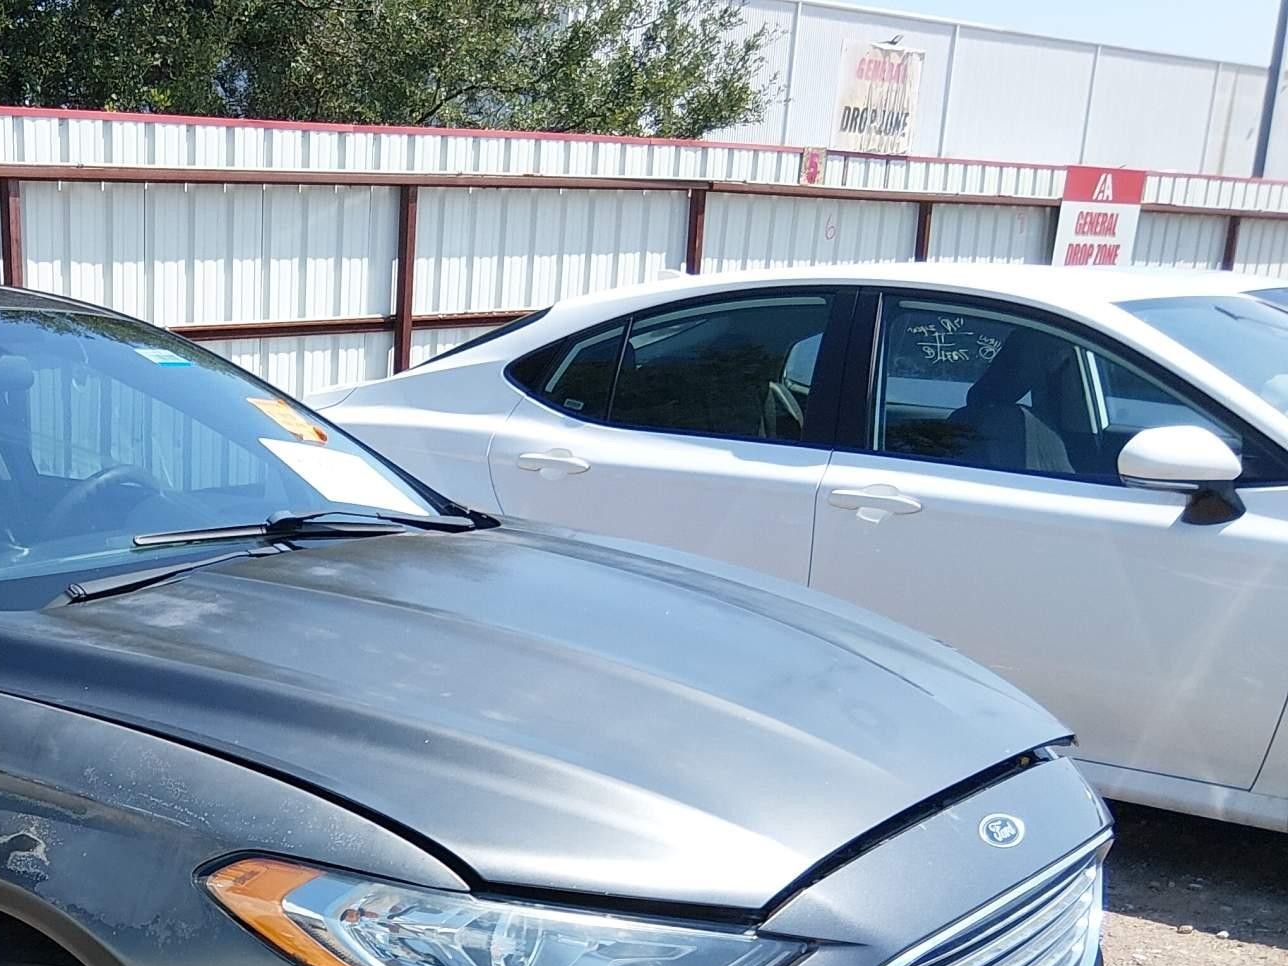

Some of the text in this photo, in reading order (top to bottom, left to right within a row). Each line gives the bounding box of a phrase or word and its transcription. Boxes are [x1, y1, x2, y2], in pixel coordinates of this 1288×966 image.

[825, 213, 837, 241] 6
[1075, 211, 1120, 237] GENERAL
[1064, 243, 1121, 266] DROP ZONE
